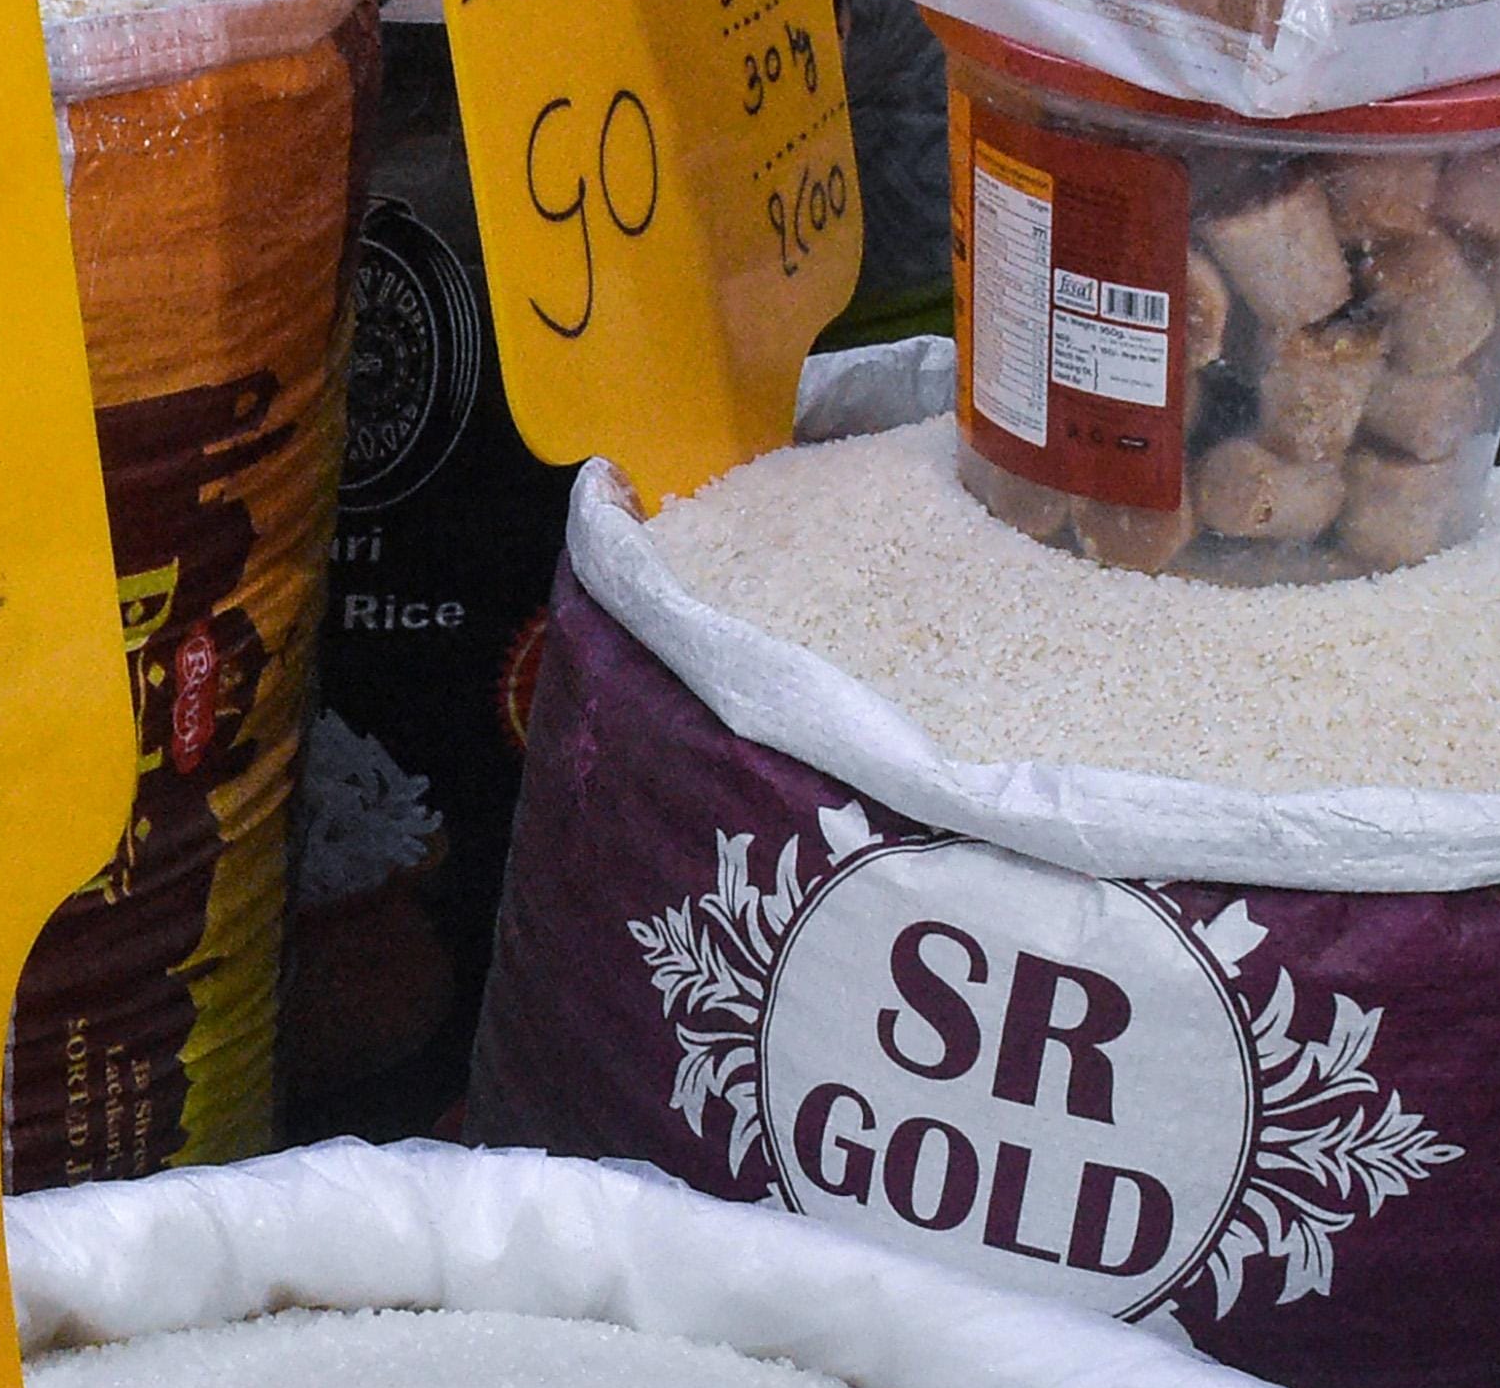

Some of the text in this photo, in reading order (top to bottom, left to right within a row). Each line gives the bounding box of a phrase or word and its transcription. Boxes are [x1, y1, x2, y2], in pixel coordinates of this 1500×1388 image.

[342, 593, 466, 632] Rice
[877, 919, 1133, 1126] SR
[792, 1079, 1177, 1280] GOLD
